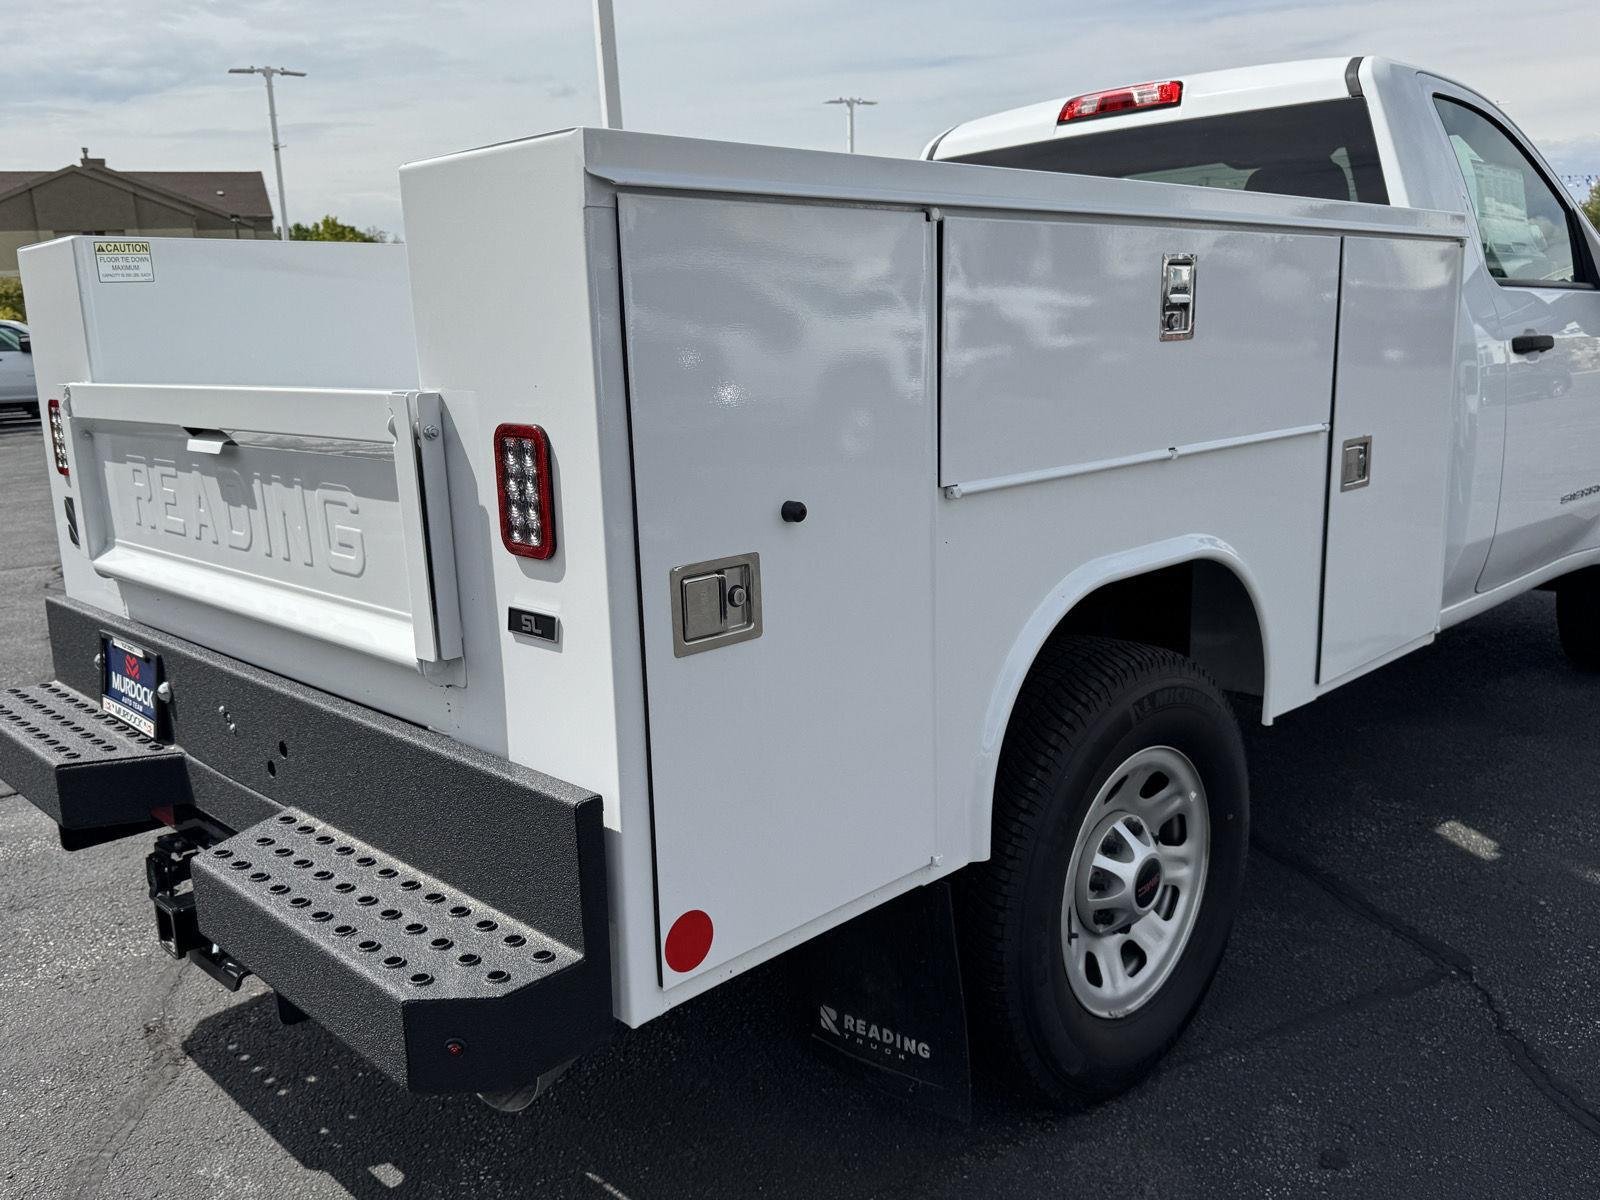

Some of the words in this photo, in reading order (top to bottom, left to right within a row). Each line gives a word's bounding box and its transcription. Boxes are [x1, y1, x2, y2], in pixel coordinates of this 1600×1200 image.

[105, 244, 149, 253] CAUTION
[126, 454, 366, 578] READING
[521, 614, 543, 635] SL
[112, 671, 154, 708] MURDOCK
[133, 701, 143, 712] TEAM
[843, 1013, 931, 1059] READING
